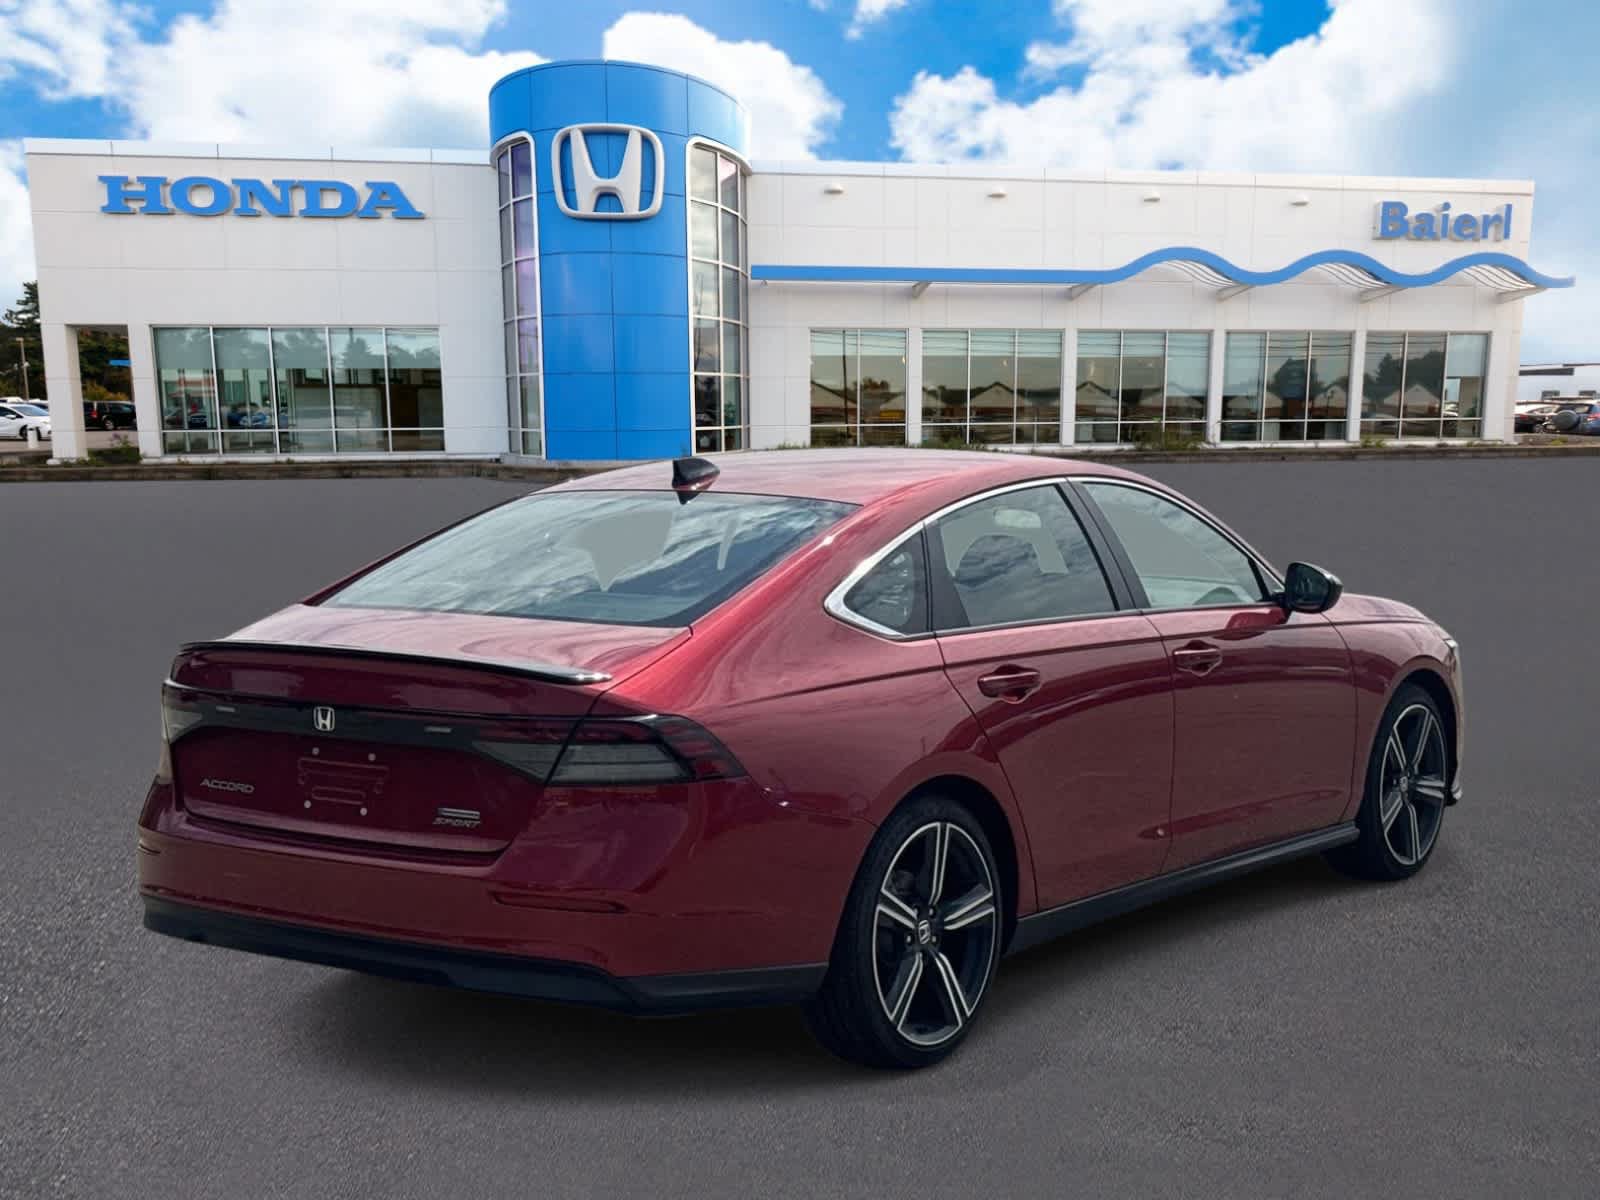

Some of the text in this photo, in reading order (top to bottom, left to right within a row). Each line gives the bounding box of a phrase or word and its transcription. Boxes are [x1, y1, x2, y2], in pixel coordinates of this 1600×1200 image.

[98, 175, 426, 219] HONDA
[1375, 200, 1513, 241] Baierl
[200, 778, 255, 793] ACCORD
